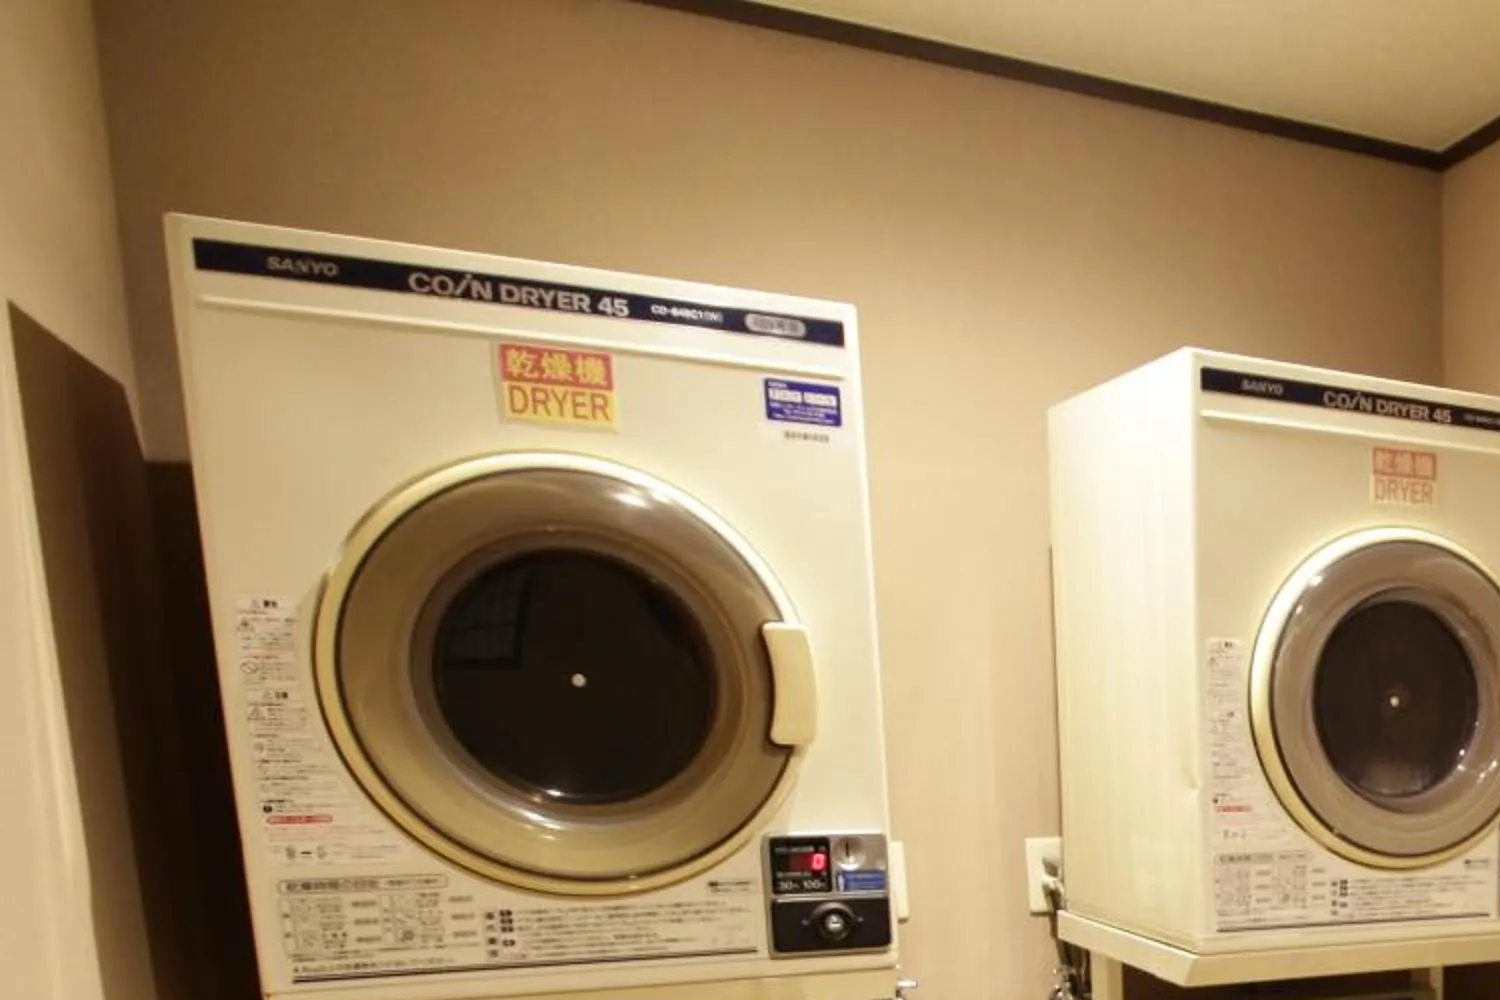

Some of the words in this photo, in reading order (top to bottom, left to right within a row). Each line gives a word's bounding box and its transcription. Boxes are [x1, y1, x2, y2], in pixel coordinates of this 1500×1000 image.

[266, 256, 339, 277] SANYO
[500, 284, 592, 313] DRYER
[598, 298, 629, 318] 45
[506, 349, 608, 385] 乾燥機
[508, 384, 610, 422] DRYER
[1376, 400, 1430, 421] DRYER
[1433, 409, 1453, 425] 45
[1375, 479, 1434, 505] DRYER
